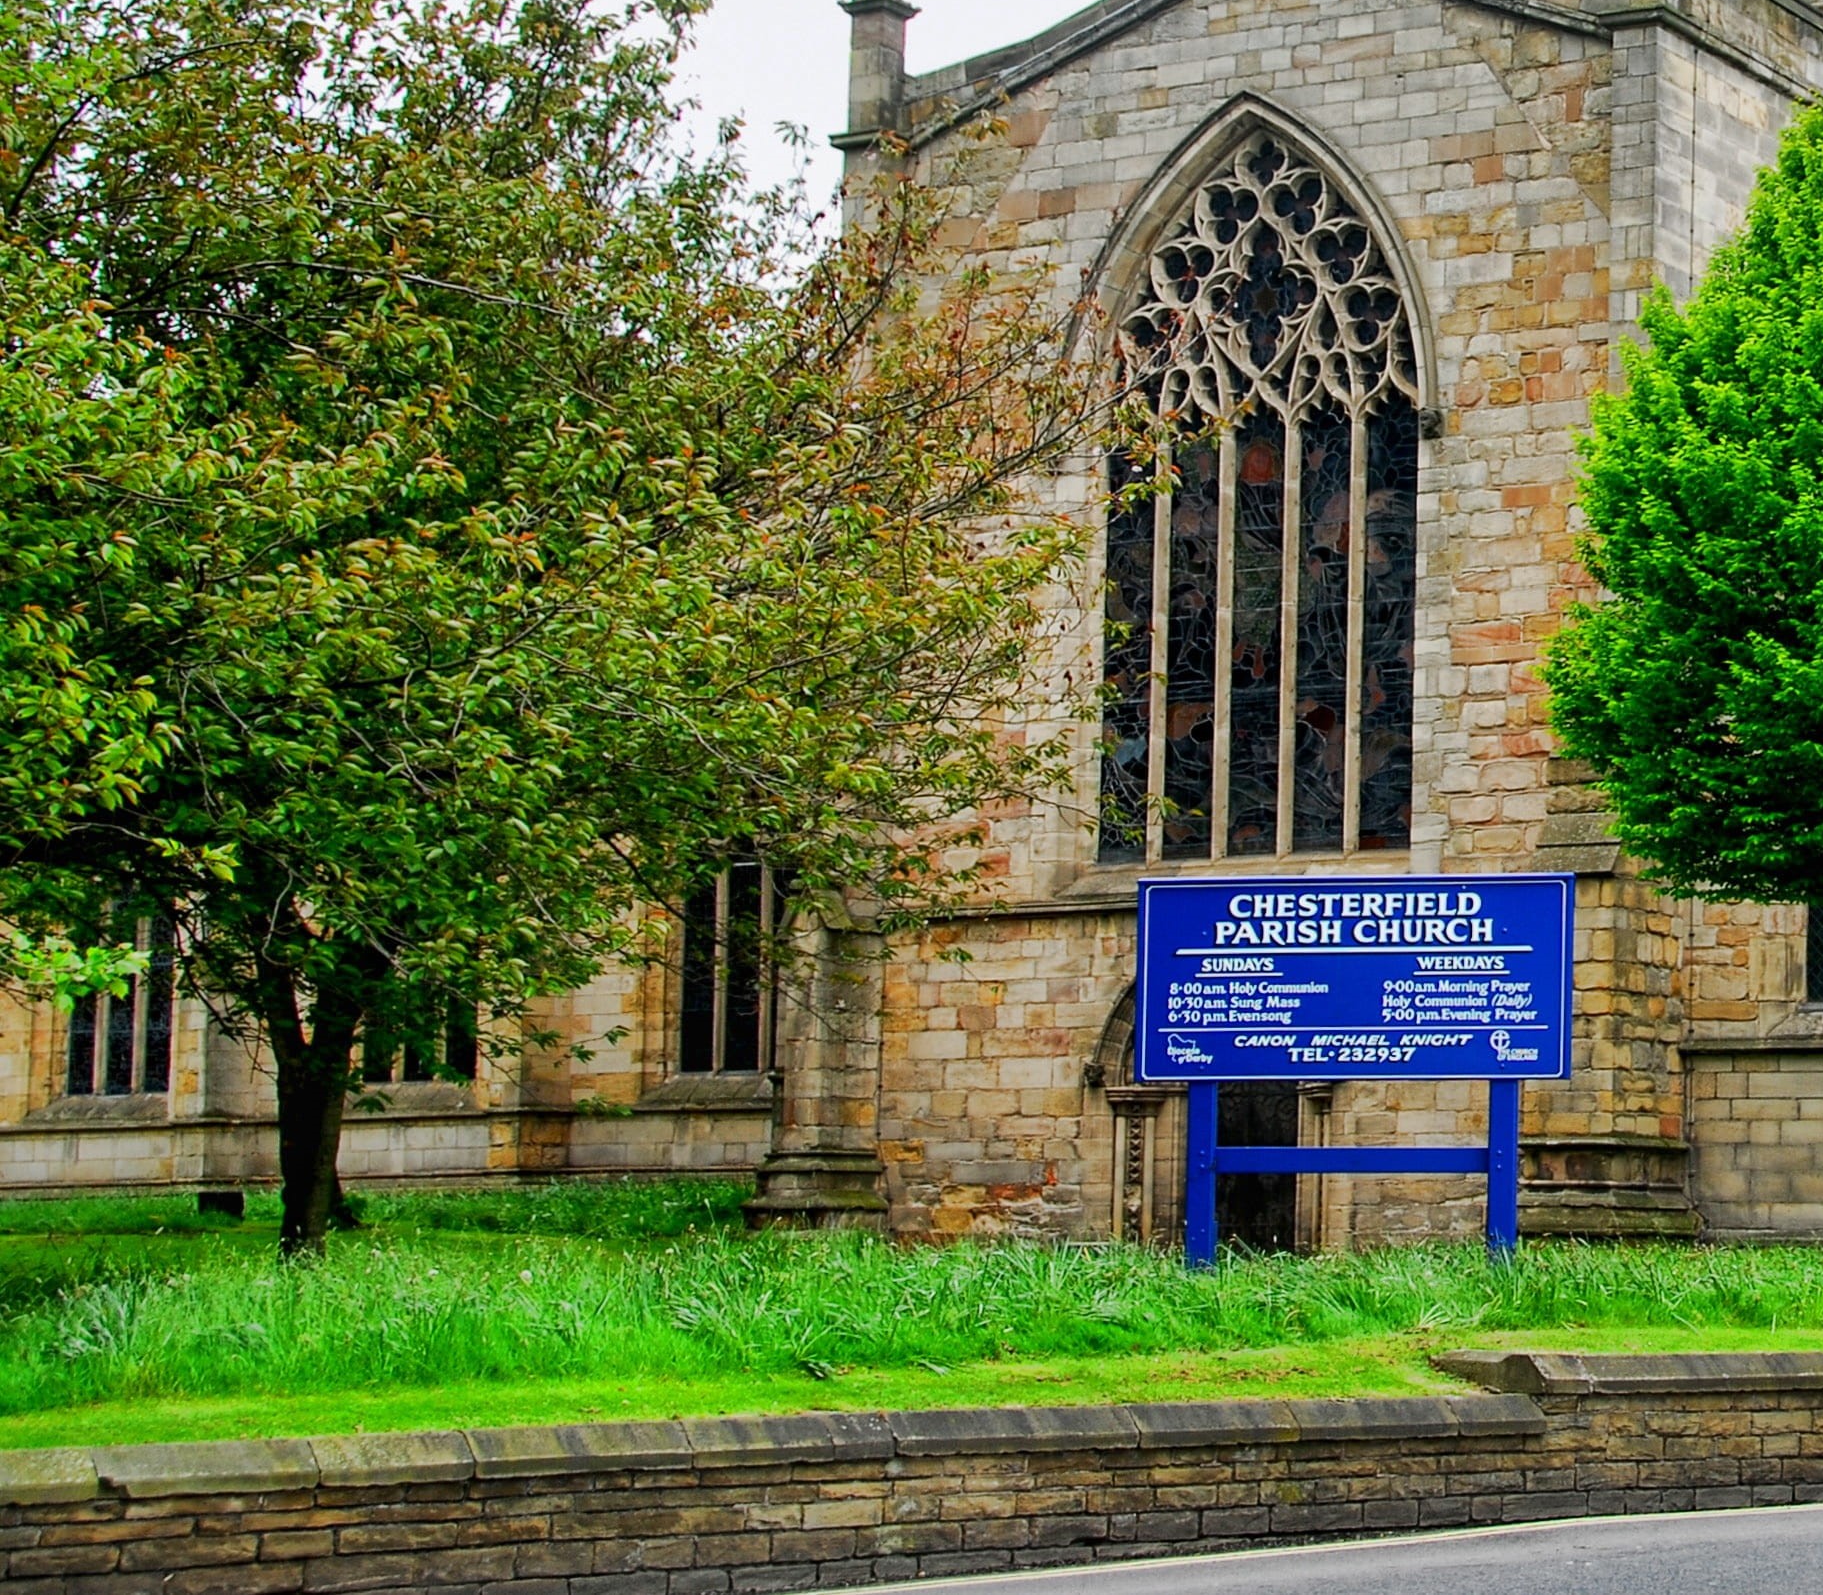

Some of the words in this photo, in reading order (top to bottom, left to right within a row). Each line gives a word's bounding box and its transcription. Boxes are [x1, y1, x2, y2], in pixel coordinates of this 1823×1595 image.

[1229, 892, 1482, 918] CHESTERFIELD
[1215, 920, 1342, 945] PARISH
[1353, 918, 1494, 944] CHURCH
[1201, 958, 1275, 972] SUNDAYS
[1416, 955, 1505, 970] WEEKDAYS
[1229, 982, 1257, 996] Holy
[1258, 981, 1329, 994] Communion
[1438, 980, 1489, 996] Morning
[1490, 980, 1531, 995] Prayer
[1230, 996, 1263, 1010] Sung
[1266, 996, 1301, 1008] Mass
[1382, 994, 1411, 1009] Holy
[1414, 994, 1487, 1007] Communion
[1491, 993, 1533, 1009] (Daily)
[1229, 1010, 1292, 1025] Evensong
[1441, 1009, 1491, 1023] Evening
[1495, 1009, 1537, 1023] Prayer
[1234, 1035, 1297, 1047] CANON
[1310, 1034, 1390, 1046] MICHAEL
[1400, 1034, 1473, 1046] KNIGHT
[1338, 1047, 1416, 1063] 232937
